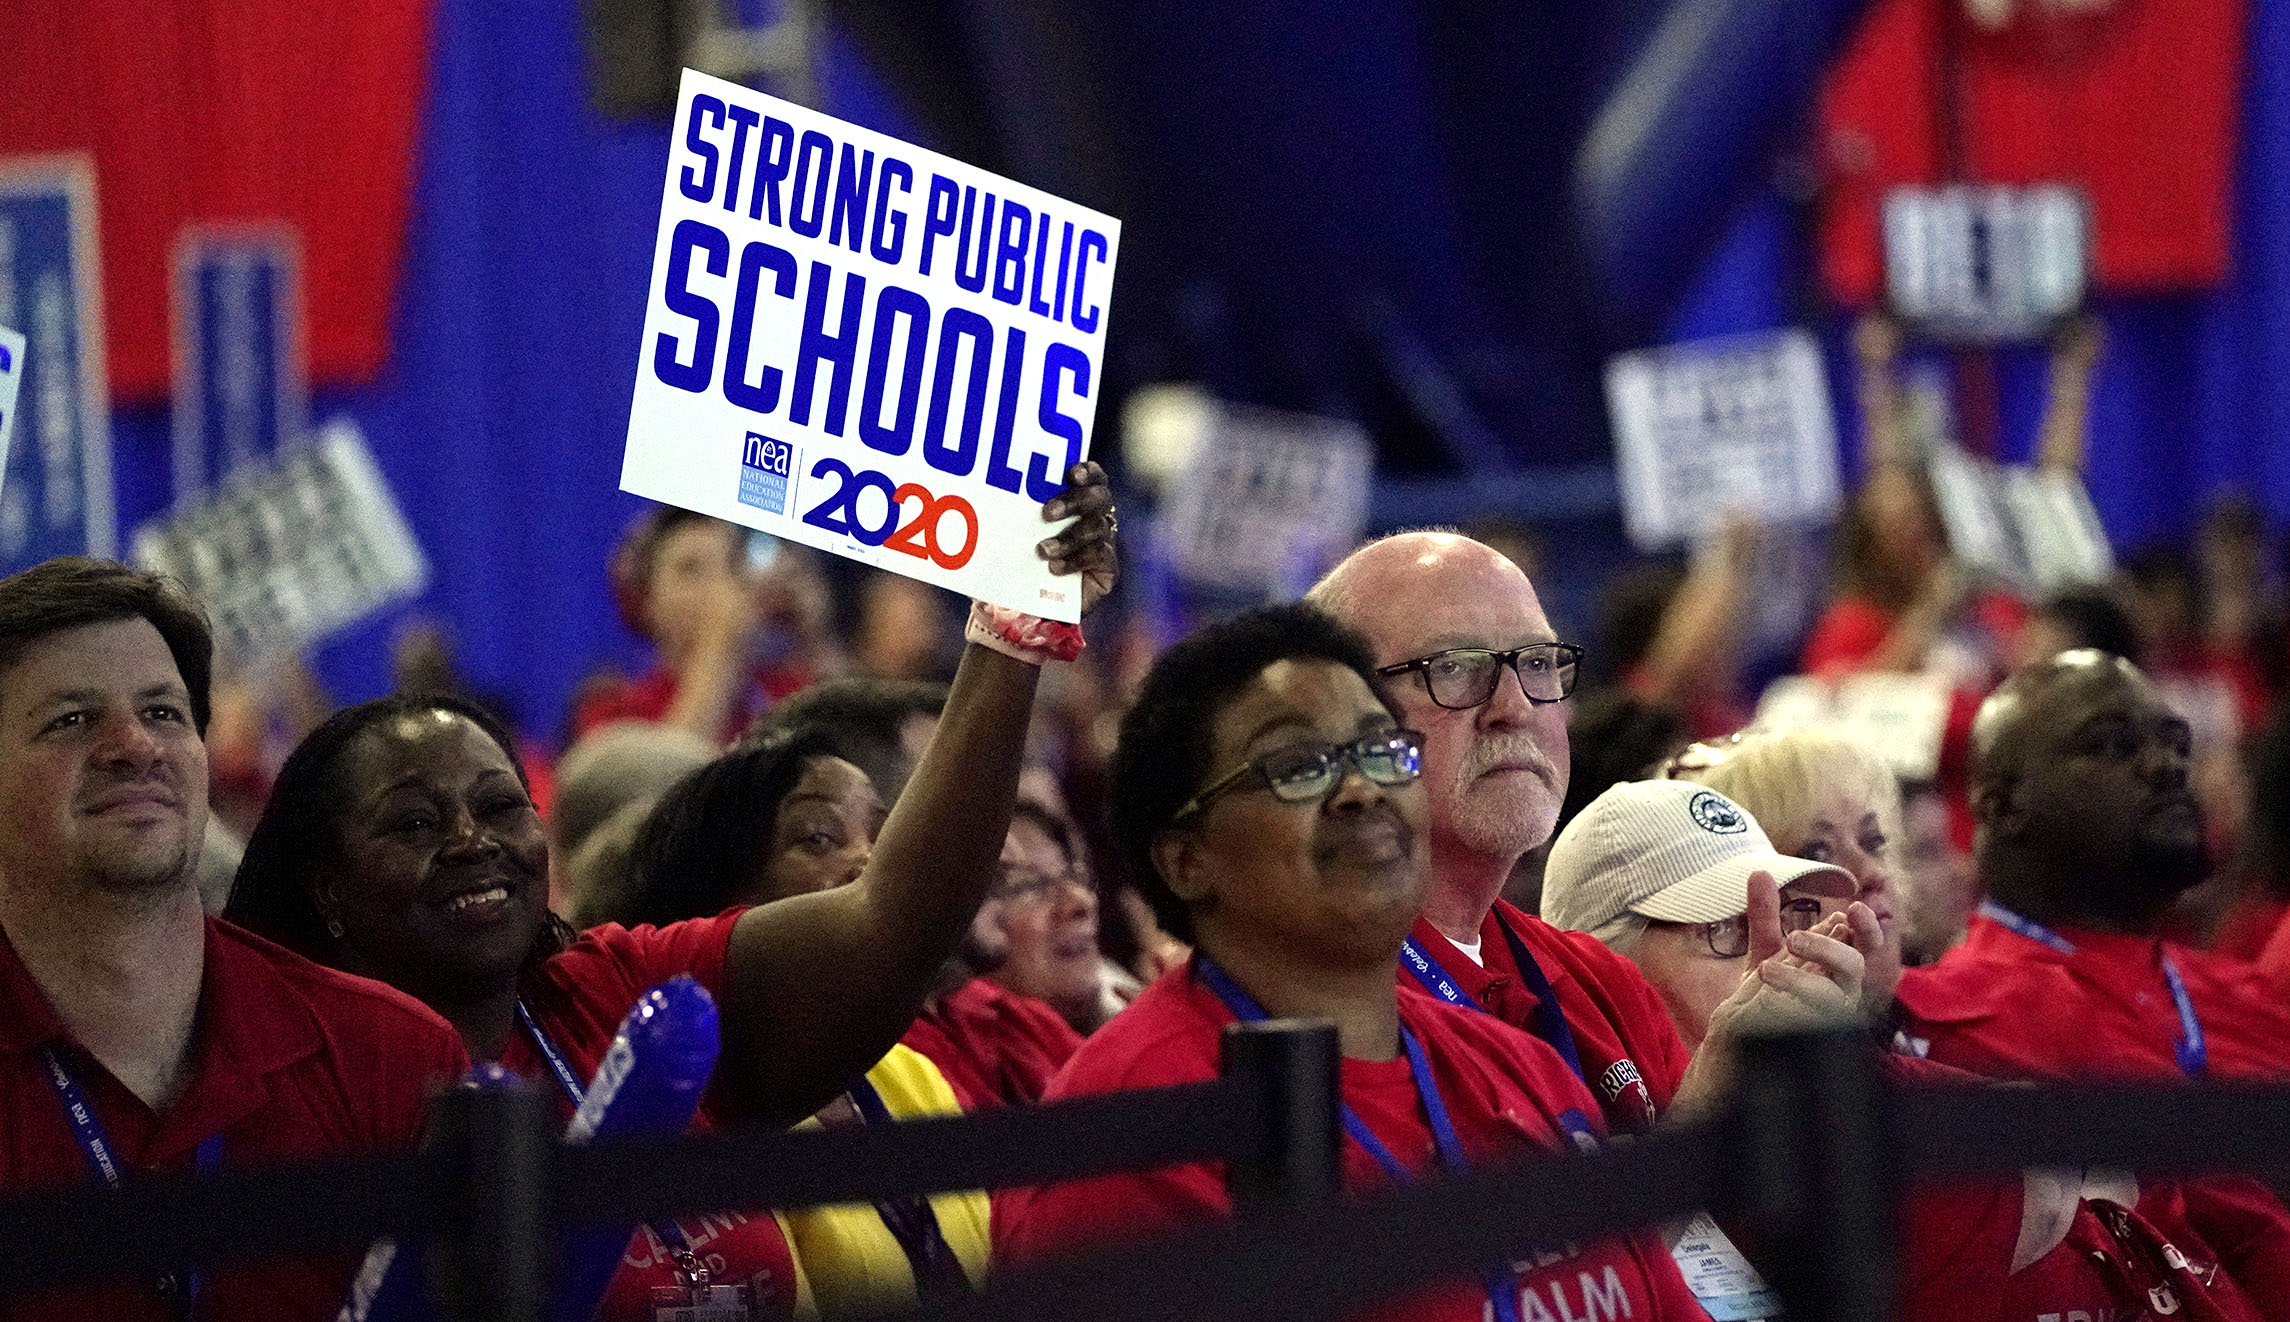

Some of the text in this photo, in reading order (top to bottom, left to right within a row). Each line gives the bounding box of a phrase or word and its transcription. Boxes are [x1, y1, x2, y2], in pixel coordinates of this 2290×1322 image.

[680, 93, 1108, 334] STRONG PUBLIC
[653, 219, 1091, 504] SCHOOLS
[743, 469, 785, 490] NATIONAL
[745, 437, 787, 475] nea
[741, 480, 784, 501] EDUCATION
[741, 491, 783, 513] ASSOCIATION
[802, 458, 978, 570] 2020
[1402, 941, 1458, 1002] nea Celebr
[1600, 1059, 1643, 1103] RICH
[72, 1103, 118, 1182] EDUCATION nea
[1483, 1264, 1632, 1322] ALM
